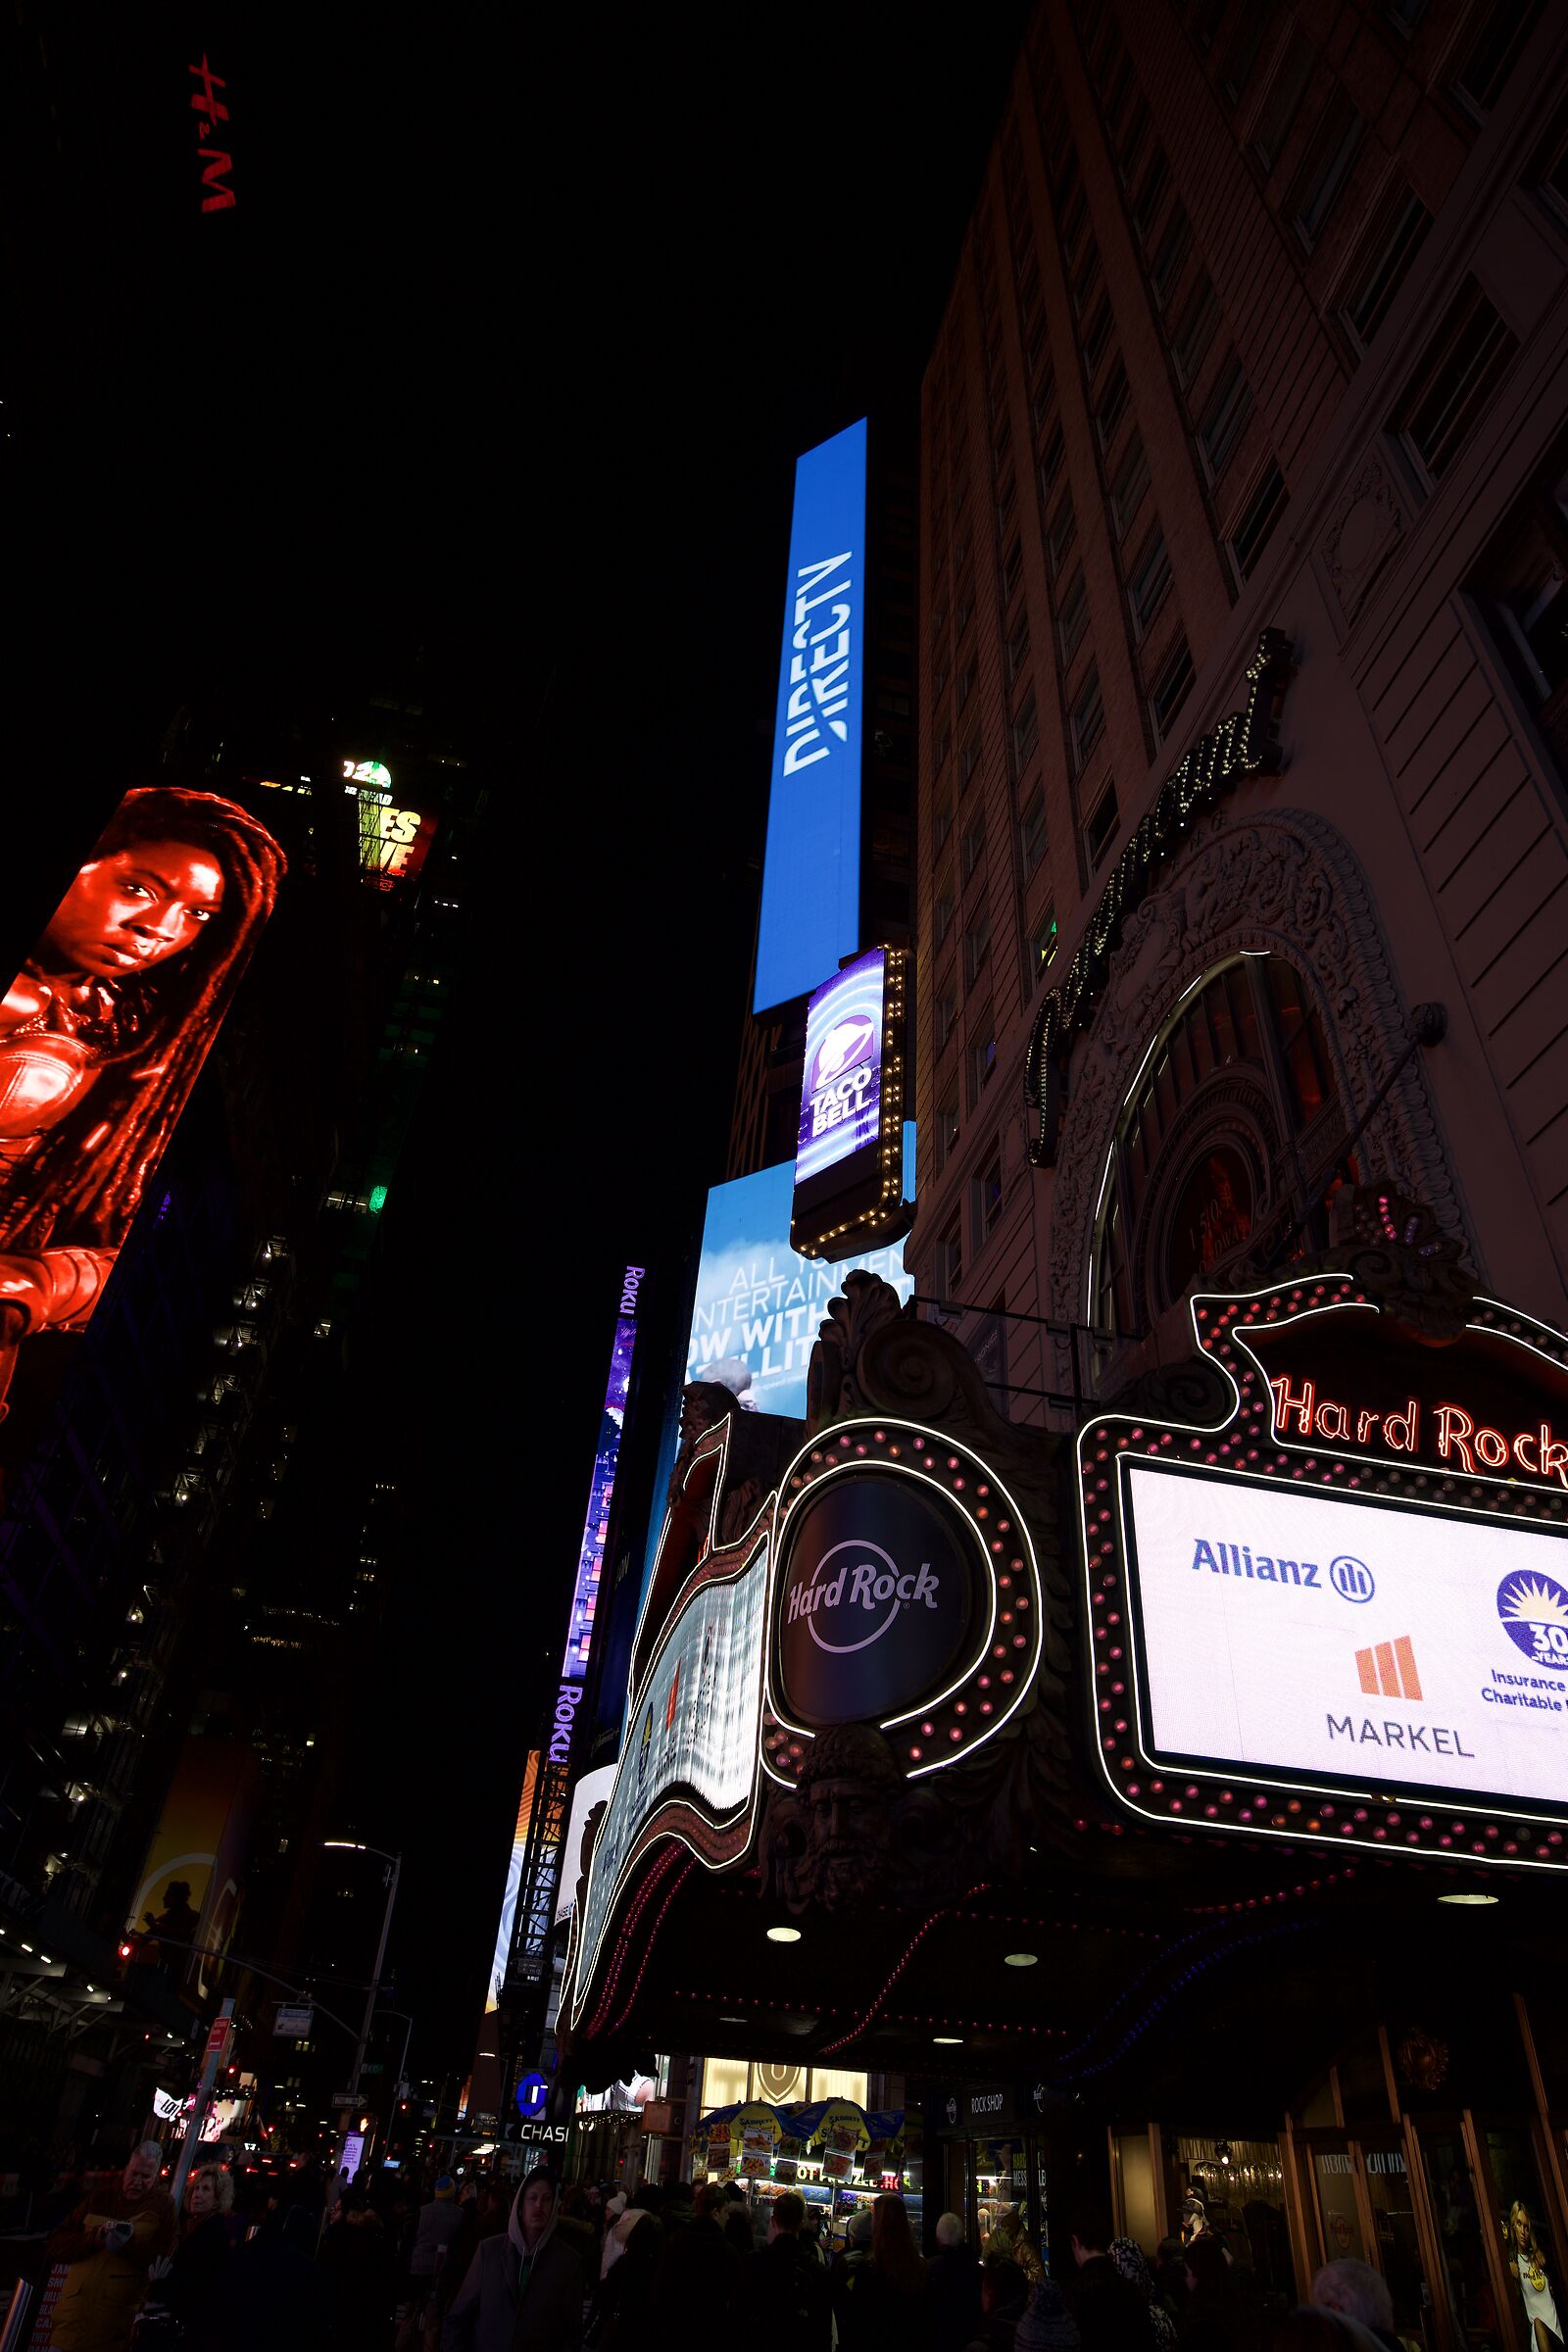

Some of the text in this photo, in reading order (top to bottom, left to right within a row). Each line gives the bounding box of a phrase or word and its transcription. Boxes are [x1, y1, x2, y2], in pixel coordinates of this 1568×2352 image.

[188, 51, 236, 215] H&M
[783, 550, 853, 776] DIRECTV
[809, 1067, 872, 1116] TACO
[812, 1091, 871, 1137] BELL
[619, 1265, 646, 1314] ROKU
[695, 1250, 904, 1333] NTERTAINMEN
[729, 1256, 785, 1296] ALL
[687, 1326, 732, 1369] OW
[1271, 1376, 1568, 1490] Hard Rock
[1192, 1538, 1322, 1589] Allianz
[787, 1562, 940, 1625] Hard Rock
[1528, 1622, 1568, 1655] 30
[1481, 1687, 1563, 1712] Charitable
[1491, 1669, 1566, 1692] Insurance
[549, 1684, 583, 1764] ROKU
[1326, 1713, 1475, 1758] MARKEL
